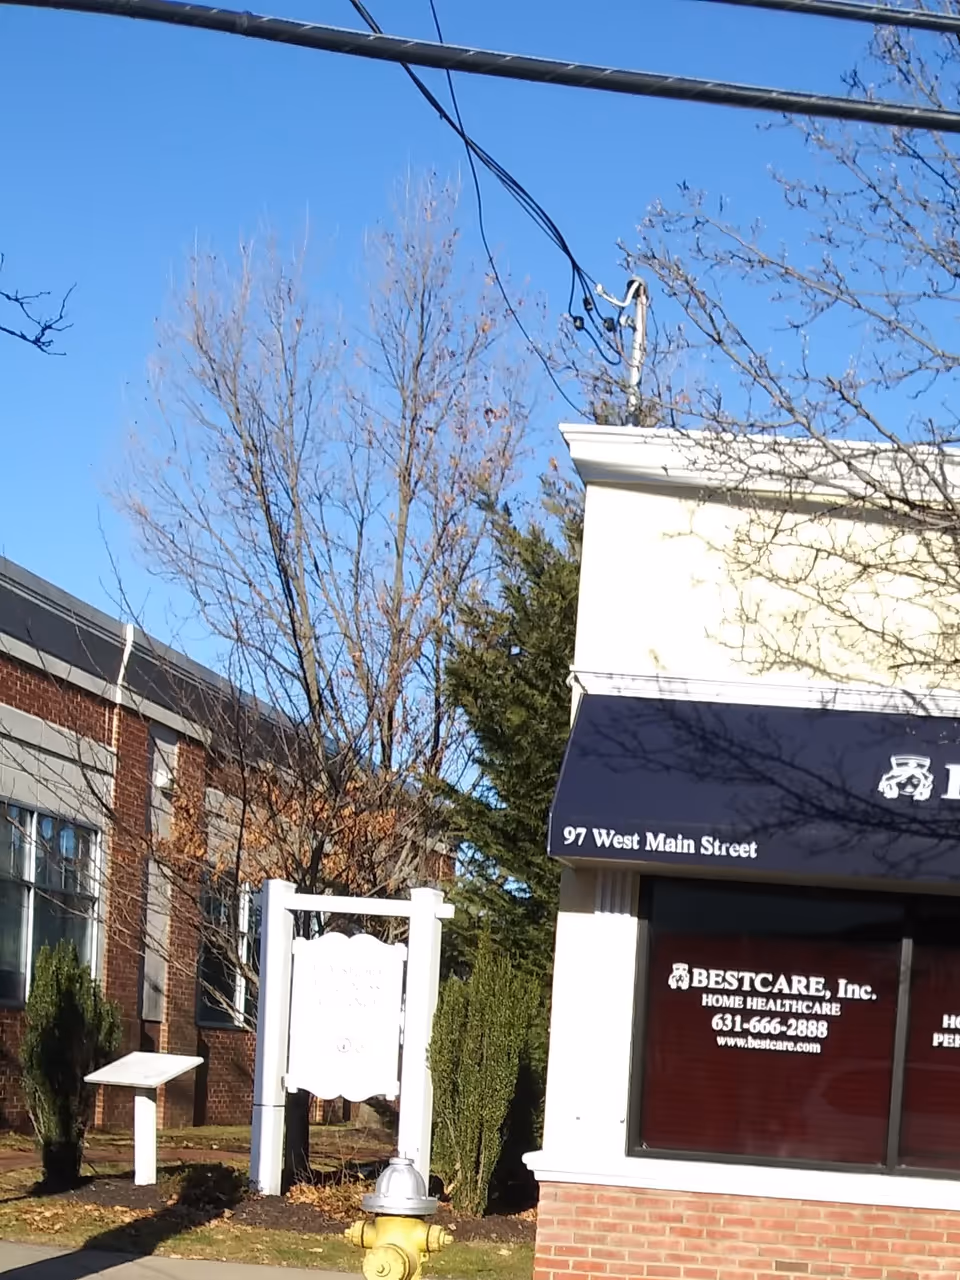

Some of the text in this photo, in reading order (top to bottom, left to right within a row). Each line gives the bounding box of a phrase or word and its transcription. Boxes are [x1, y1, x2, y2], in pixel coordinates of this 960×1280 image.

[563, 826, 758, 858] 97 West Main Street
[692, 968, 878, 1000] BESTCARE, Inc.
[702, 993, 841, 1016] HOME HEALTHCARE
[711, 1013, 828, 1038] 631-666-2888
[716, 1036, 821, 1053] www.bestcare.com
